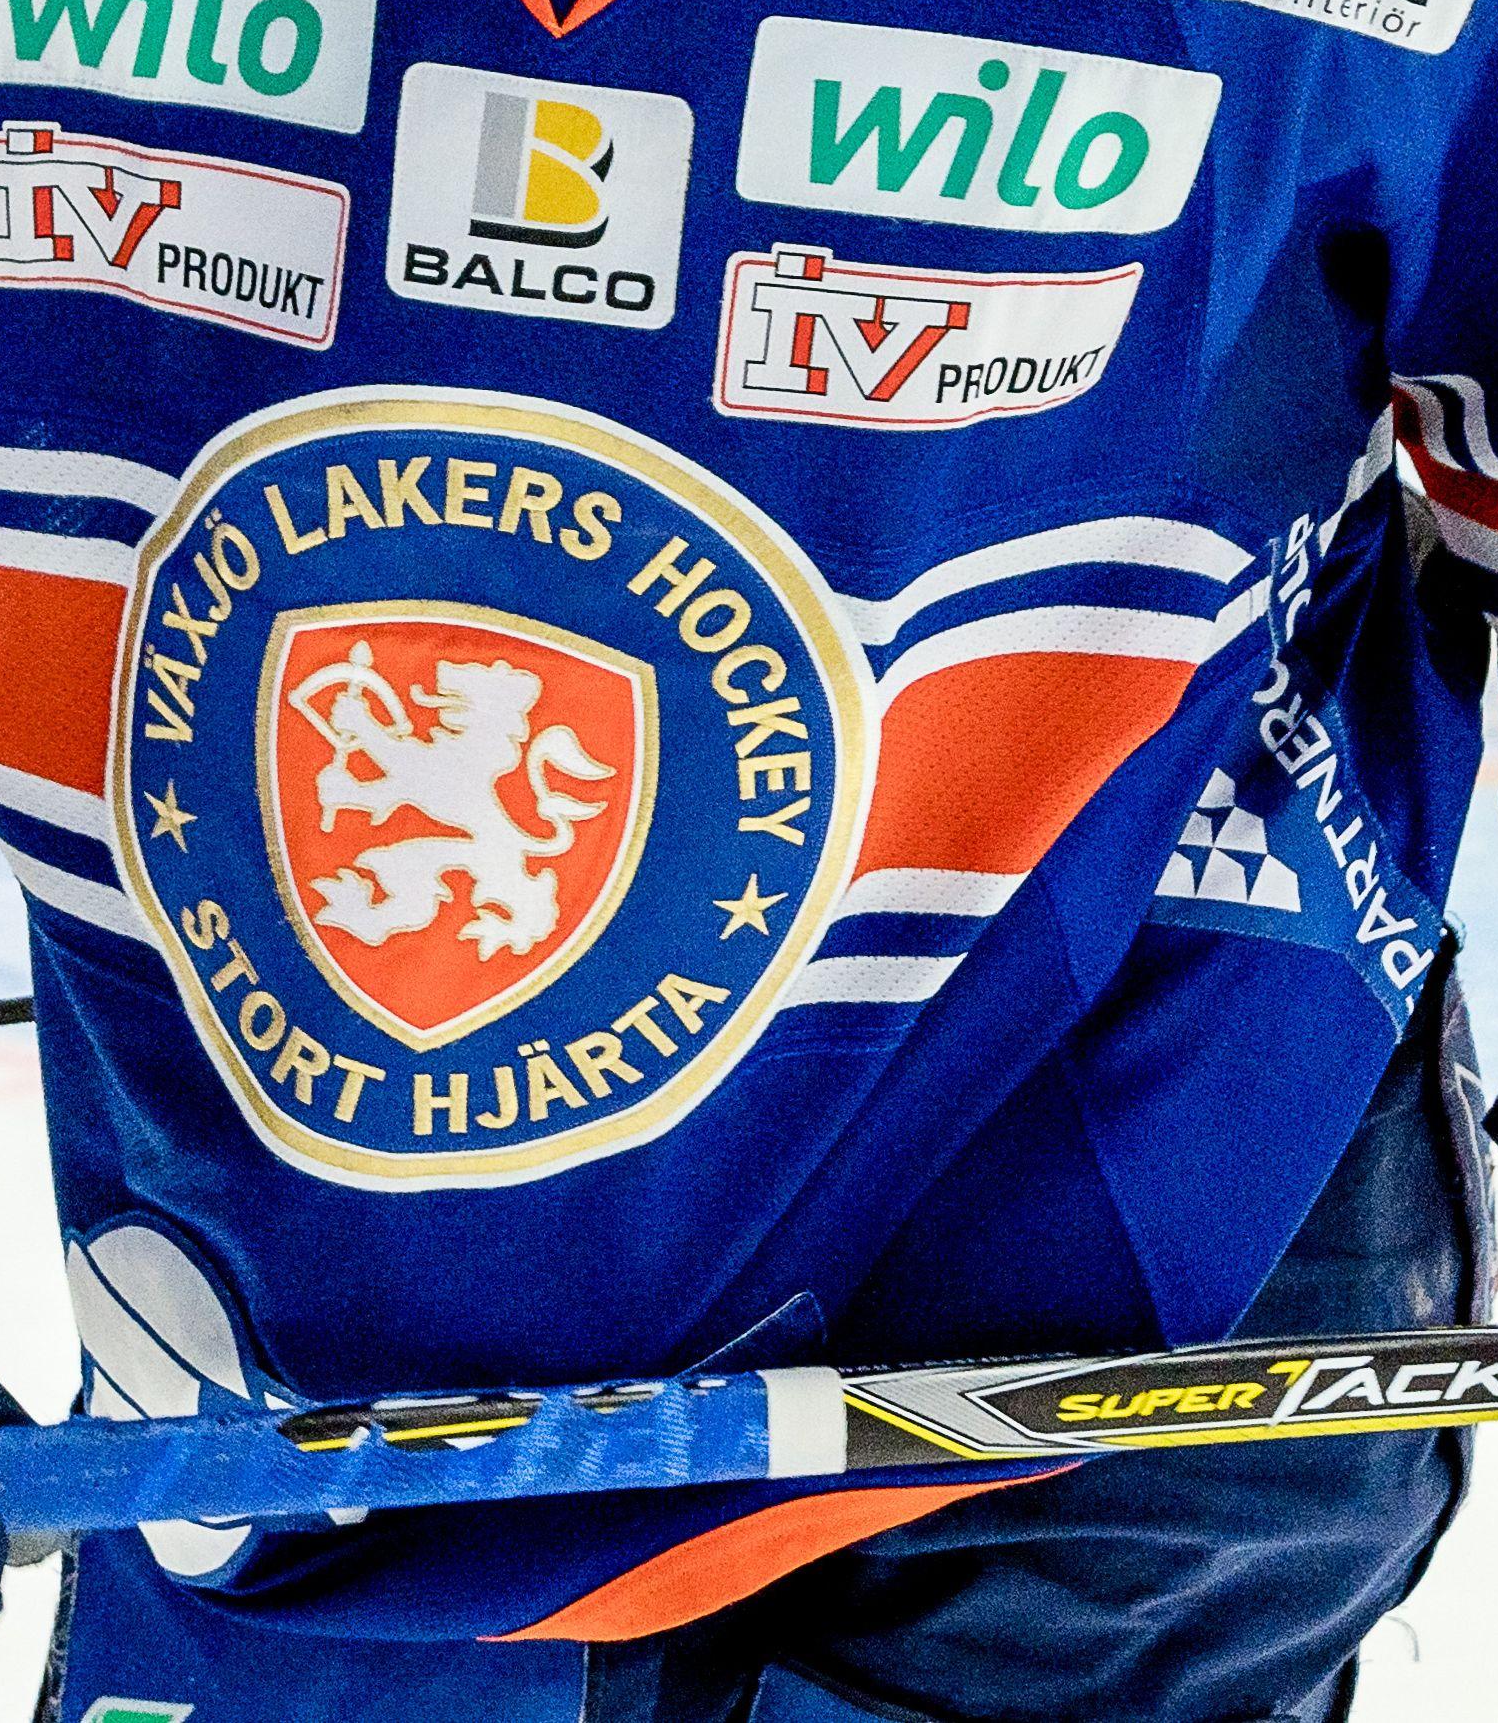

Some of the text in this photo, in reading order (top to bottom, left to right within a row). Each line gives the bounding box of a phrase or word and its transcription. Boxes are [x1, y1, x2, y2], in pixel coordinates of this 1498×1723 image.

[810, 58, 1151, 211] wilo
[156, 245, 324, 323] PRODUKT
[404, 243, 656, 312] BALCO
[936, 346, 1108, 405] PRODUKT
[144, 455, 814, 846] VÄXJÖ LAKERS HOCKEY
[184, 898, 733, 1136] STORT HJÄRTA
[1055, 1382, 1264, 1422] SUPER
